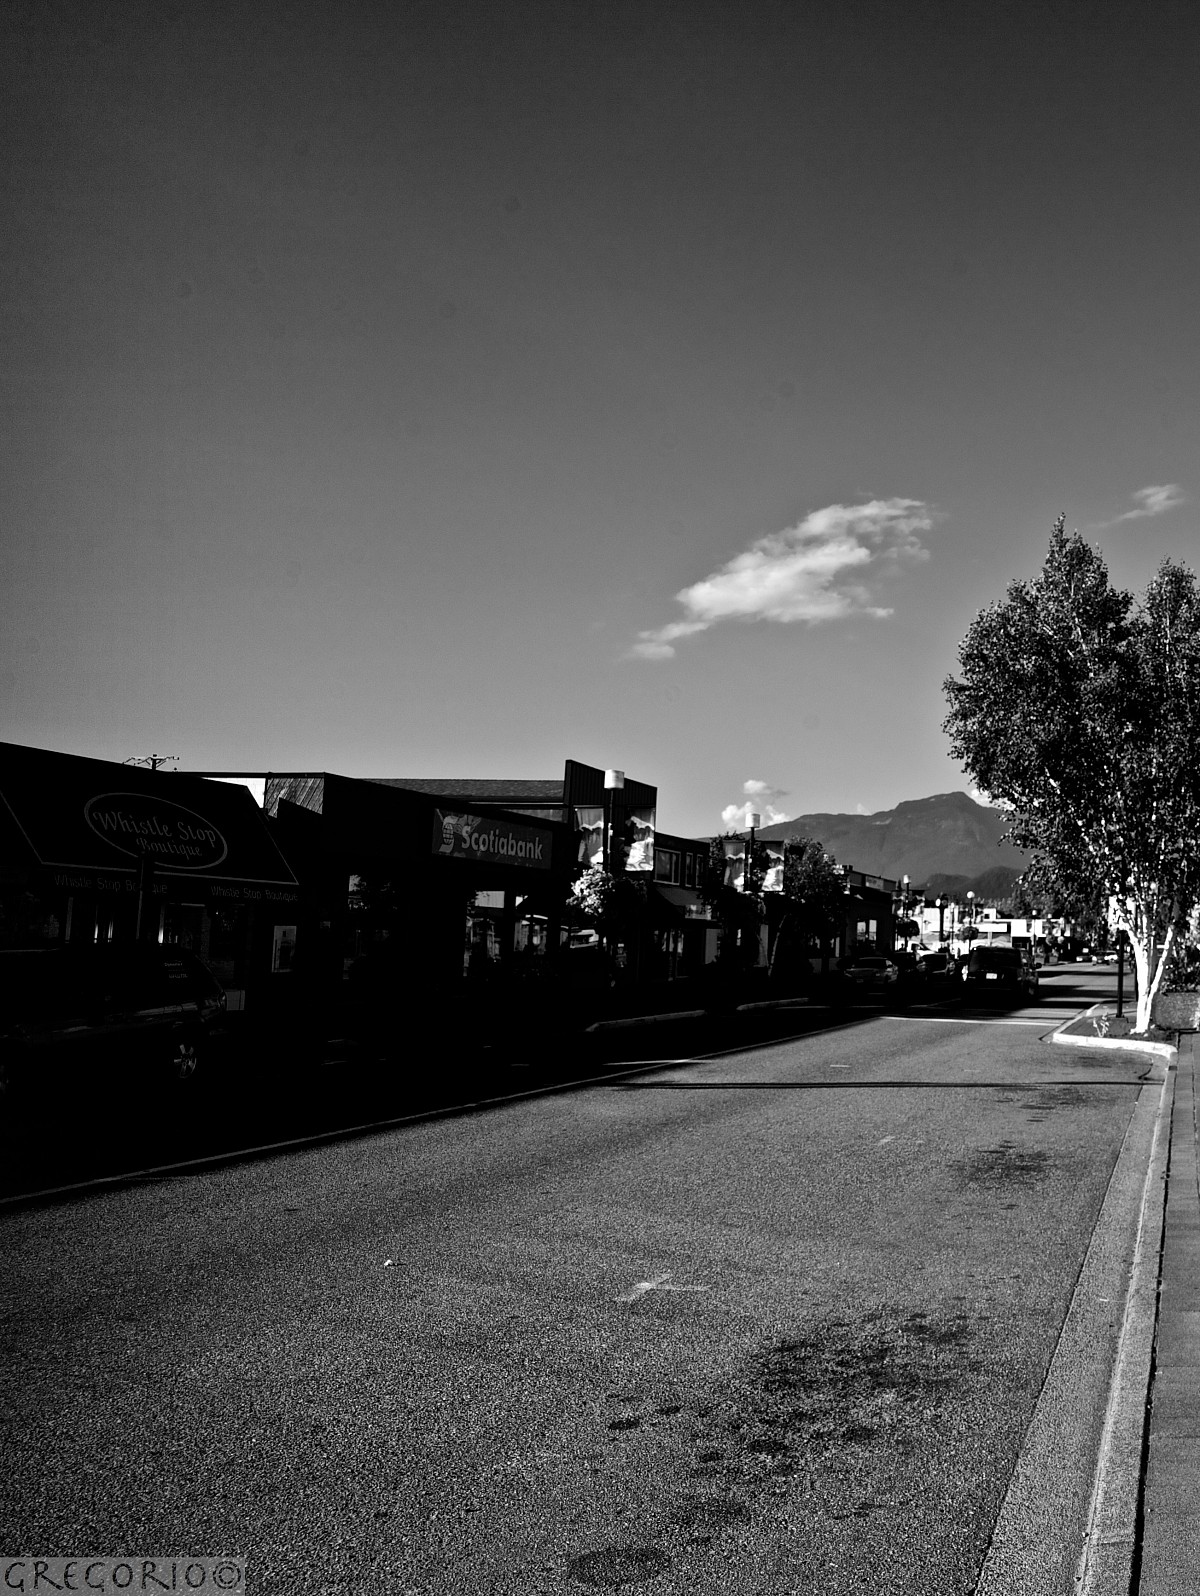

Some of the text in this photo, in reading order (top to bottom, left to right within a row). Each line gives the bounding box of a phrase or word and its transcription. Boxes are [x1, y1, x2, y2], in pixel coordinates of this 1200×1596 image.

[92, 810, 216, 848] Whistle Stop
[136, 837, 203, 861] Boutique
[461, 825, 543, 860] Scotiabank
[96, 877, 121, 893] Stop
[243, 887, 262, 900] Stop
